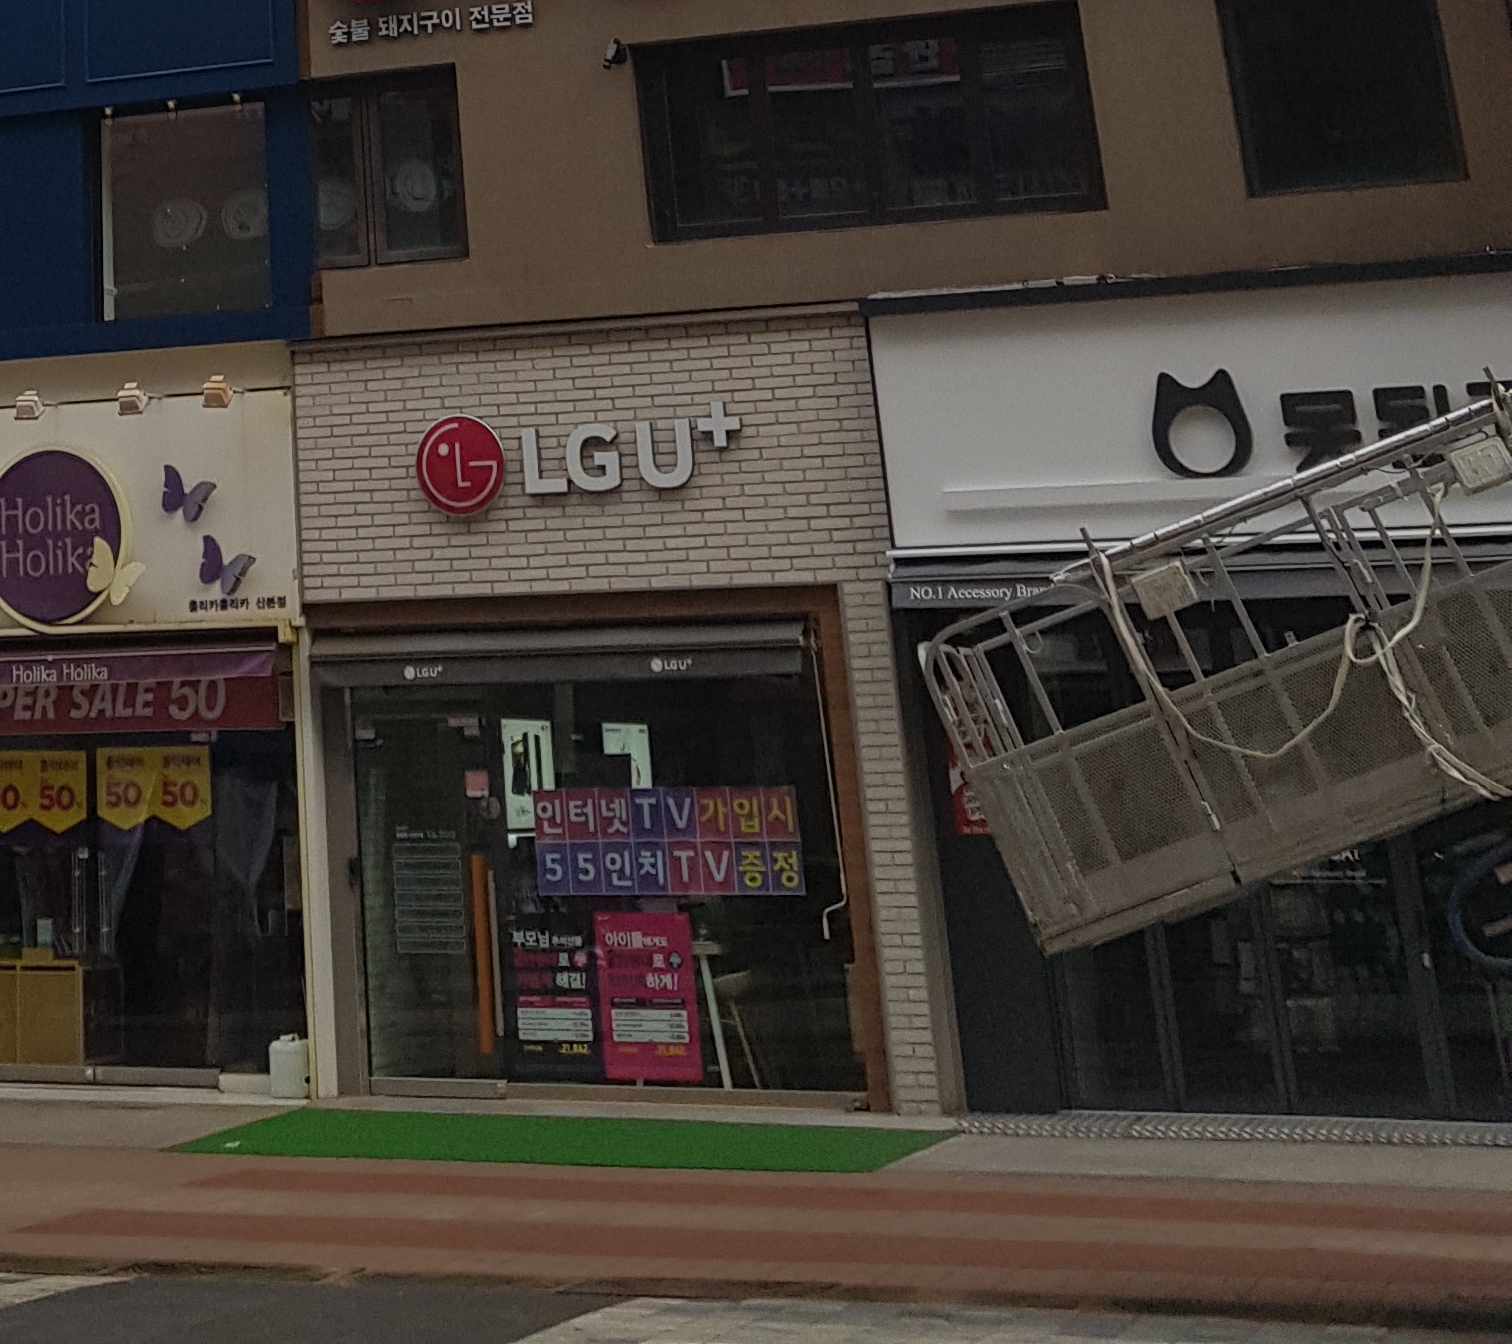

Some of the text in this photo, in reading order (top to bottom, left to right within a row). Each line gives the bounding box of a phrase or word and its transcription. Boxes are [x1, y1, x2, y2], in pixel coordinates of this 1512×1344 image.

[328, 17, 371, 45] 숯불
[377, 6, 462, 38] 돼지구이
[0, 493, 102, 536] Holika
[947, 586, 1013, 601] Accessory
[11, 661, 109, 685] Holika Holika
[67, 678, 157, 720] SALE
